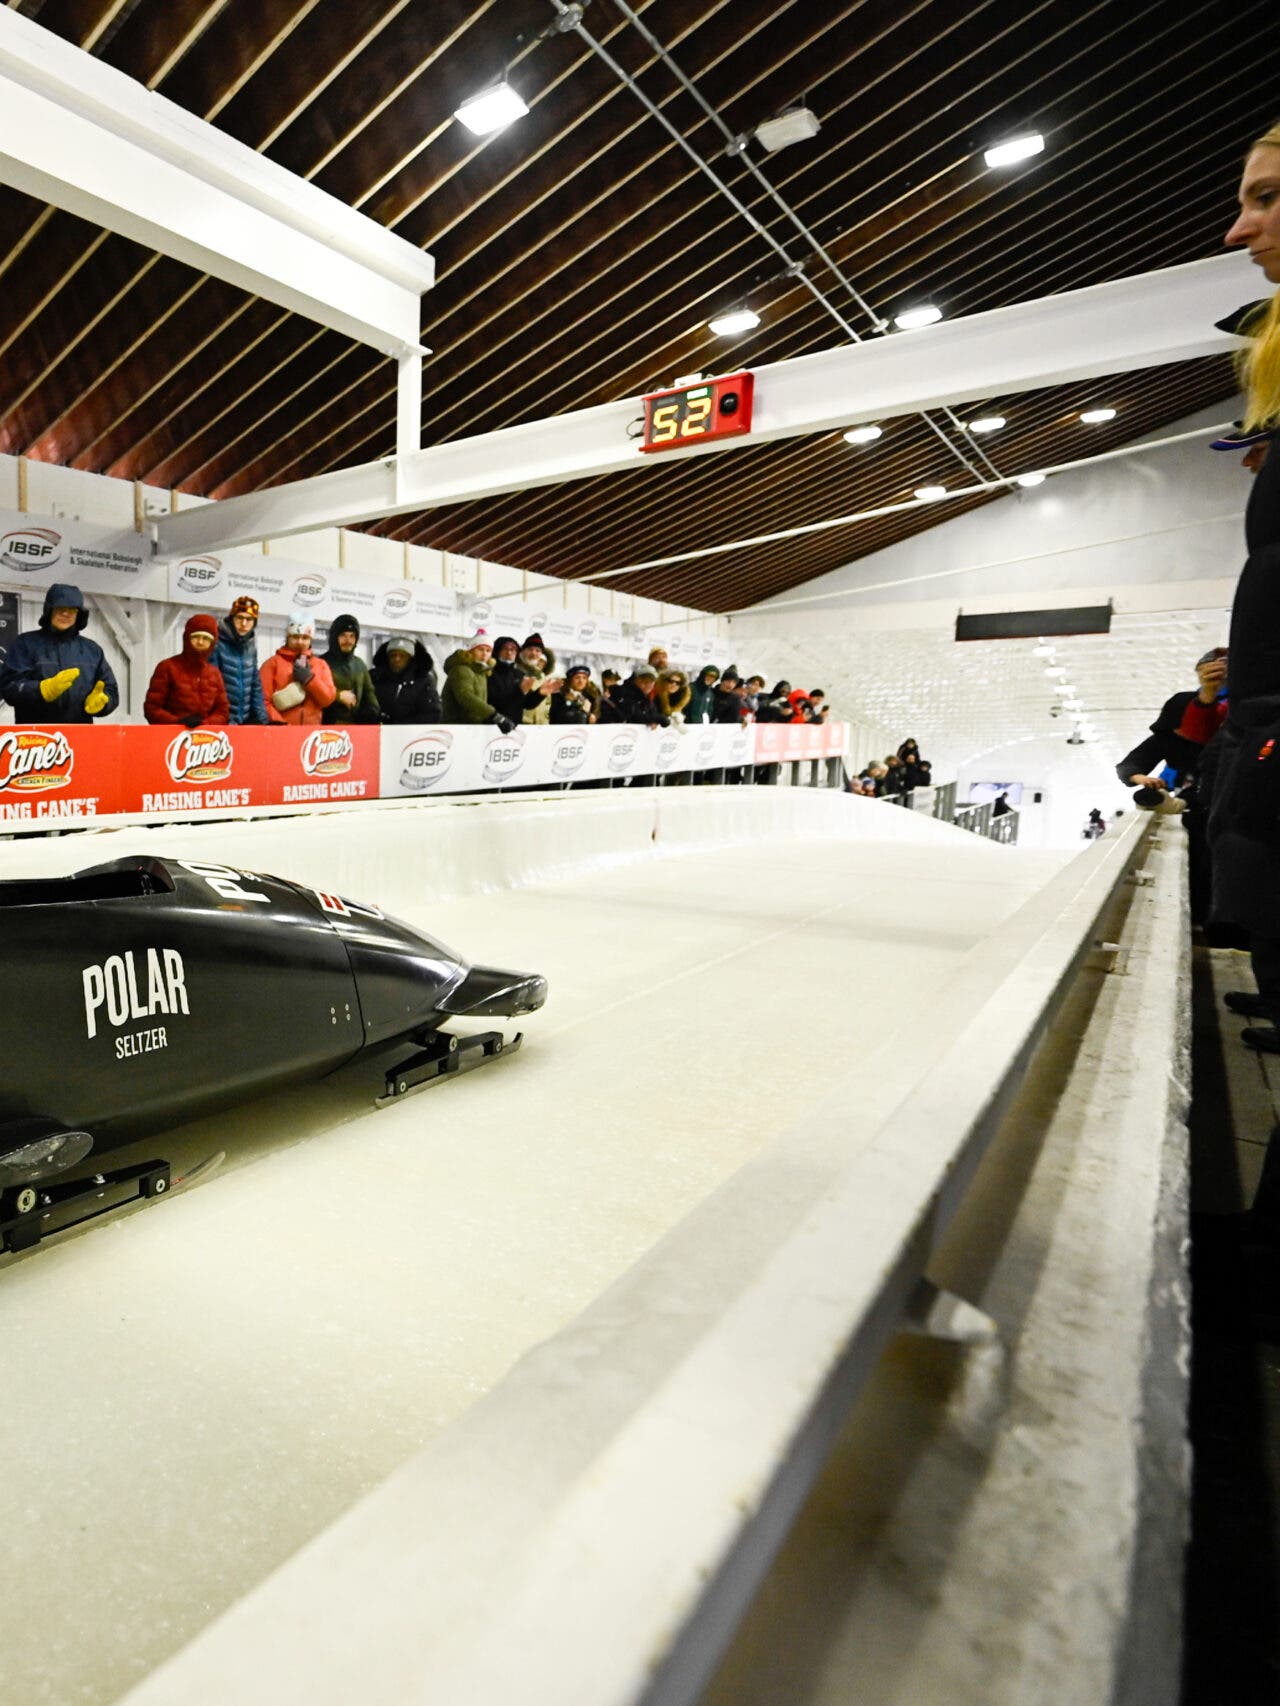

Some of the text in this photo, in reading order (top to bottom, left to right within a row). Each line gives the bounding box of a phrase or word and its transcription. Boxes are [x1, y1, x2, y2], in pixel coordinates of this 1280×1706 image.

[652, 397, 712, 443] 52
[9, 540, 54, 557] IBSF
[184, 566, 216, 581] IBSF
[297, 584, 322, 596] IBSF
[170, 730, 232, 779] Cane's
[408, 751, 447, 768] IBSF
[489, 748, 521, 763] IBSF
[557, 745, 584, 760] IBSF
[142, 788, 249, 812] RAISING CANE'S
[283, 780, 366, 802] RAISING CANE'S
[37, 797, 97, 818] CANE'S
[83, 948, 190, 1039] POLAR
[115, 1026, 168, 1060] SELTZER
